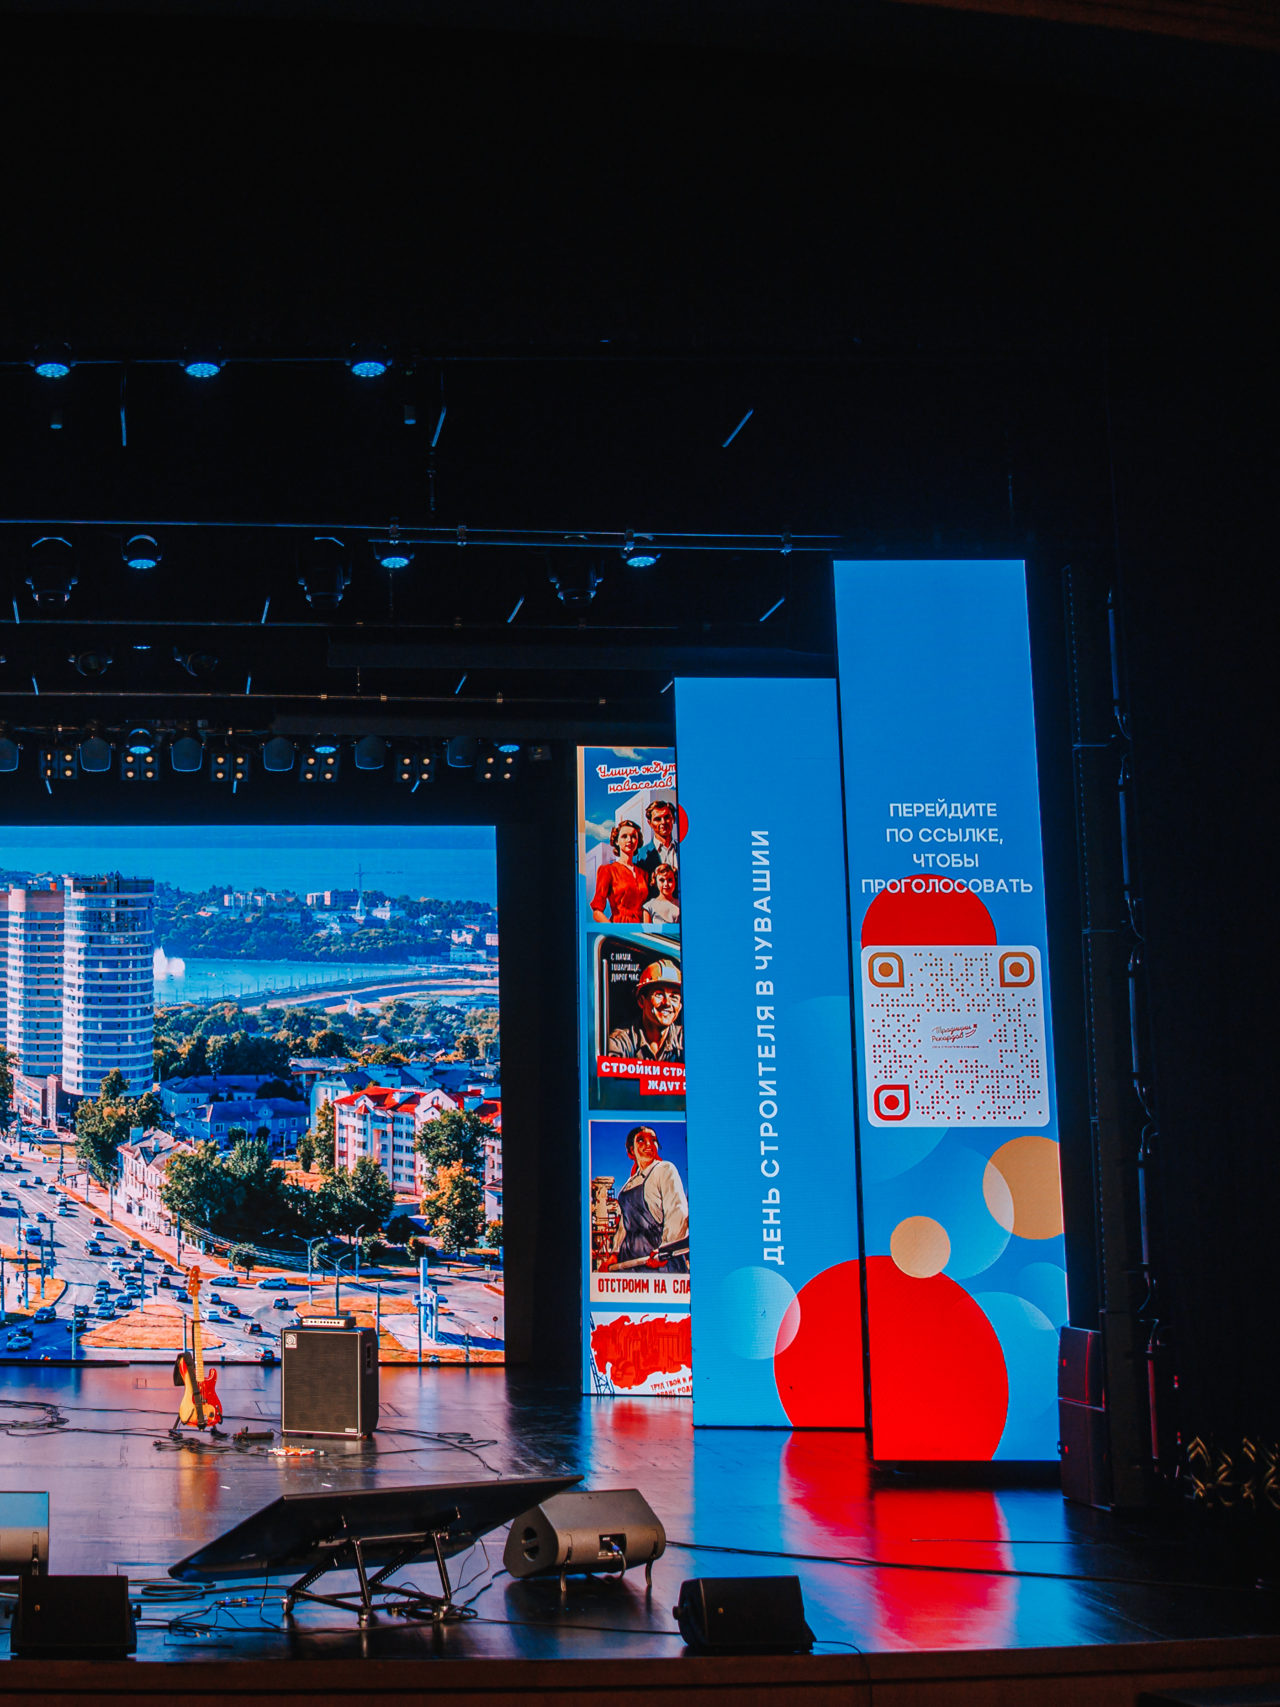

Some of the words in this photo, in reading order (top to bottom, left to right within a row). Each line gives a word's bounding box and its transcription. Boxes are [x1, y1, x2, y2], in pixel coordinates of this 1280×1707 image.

[597, 764, 639, 778] Улицы
[642, 760, 677, 778] ждут
[889, 798, 998, 818] ПЕРЕЙДИТЕ
[886, 828, 916, 843] ПО
[918, 827, 1004, 845] ССЫЛКЕ,
[912, 853, 979, 868] ЧТОБЫ
[861, 878, 1033, 895] ПРОГОЛОСОВАТЬ
[751, 830, 773, 971] ЧУВАШИИ
[755, 980, 775, 996] В
[601, 1060, 661, 1076] СТРОЙКИ
[647, 1079, 681, 1092] ЖДУТ
[756, 1005, 780, 1178] СТРОИТЕЛЯ
[762, 1187, 785, 1266] ДЕНЬ
[597, 1278, 650, 1293] ОТСТРОИМ
[653, 1279, 668, 1294] НА
